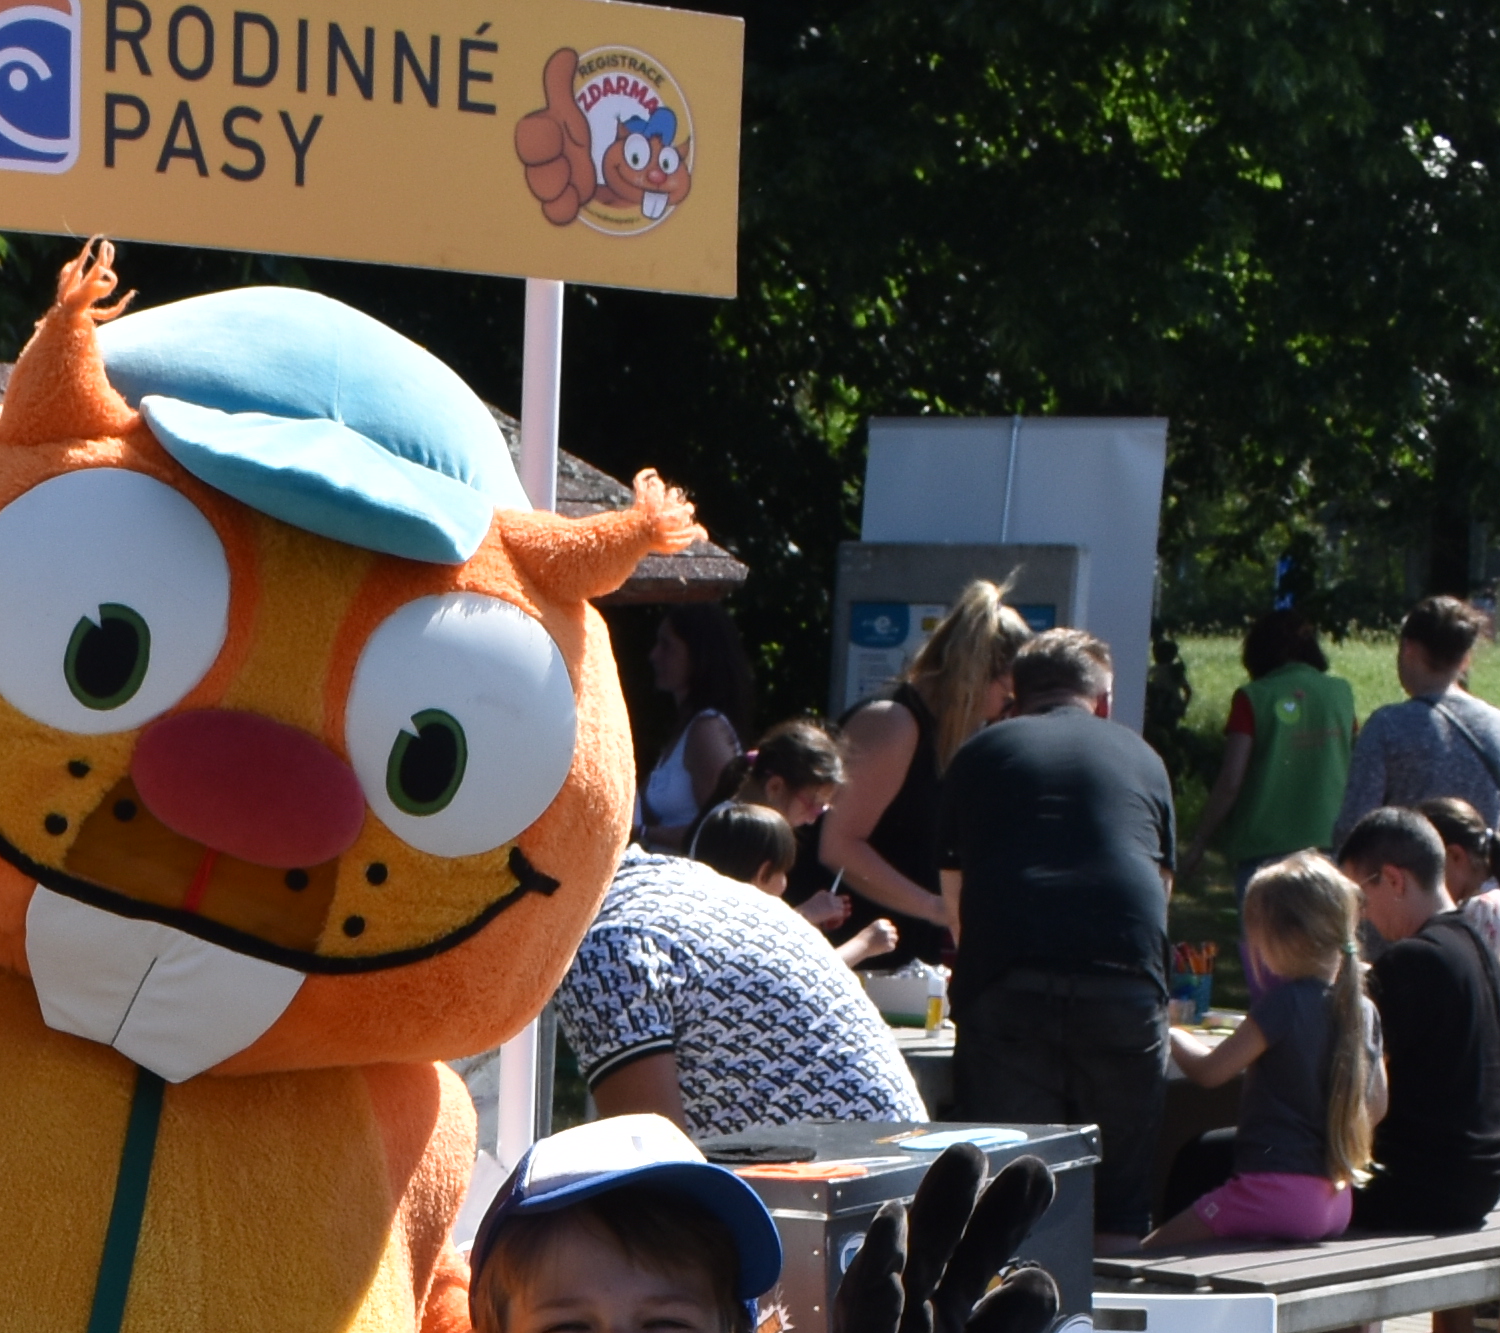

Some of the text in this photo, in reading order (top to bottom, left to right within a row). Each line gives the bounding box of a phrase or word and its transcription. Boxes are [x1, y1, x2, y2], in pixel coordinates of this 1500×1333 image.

[104, 0, 499, 115] RODINNÉ
[578, 54, 666, 88] REGISTRACE
[577, 75, 660, 114] ZDARMA
[103, 91, 324, 188] PASY
